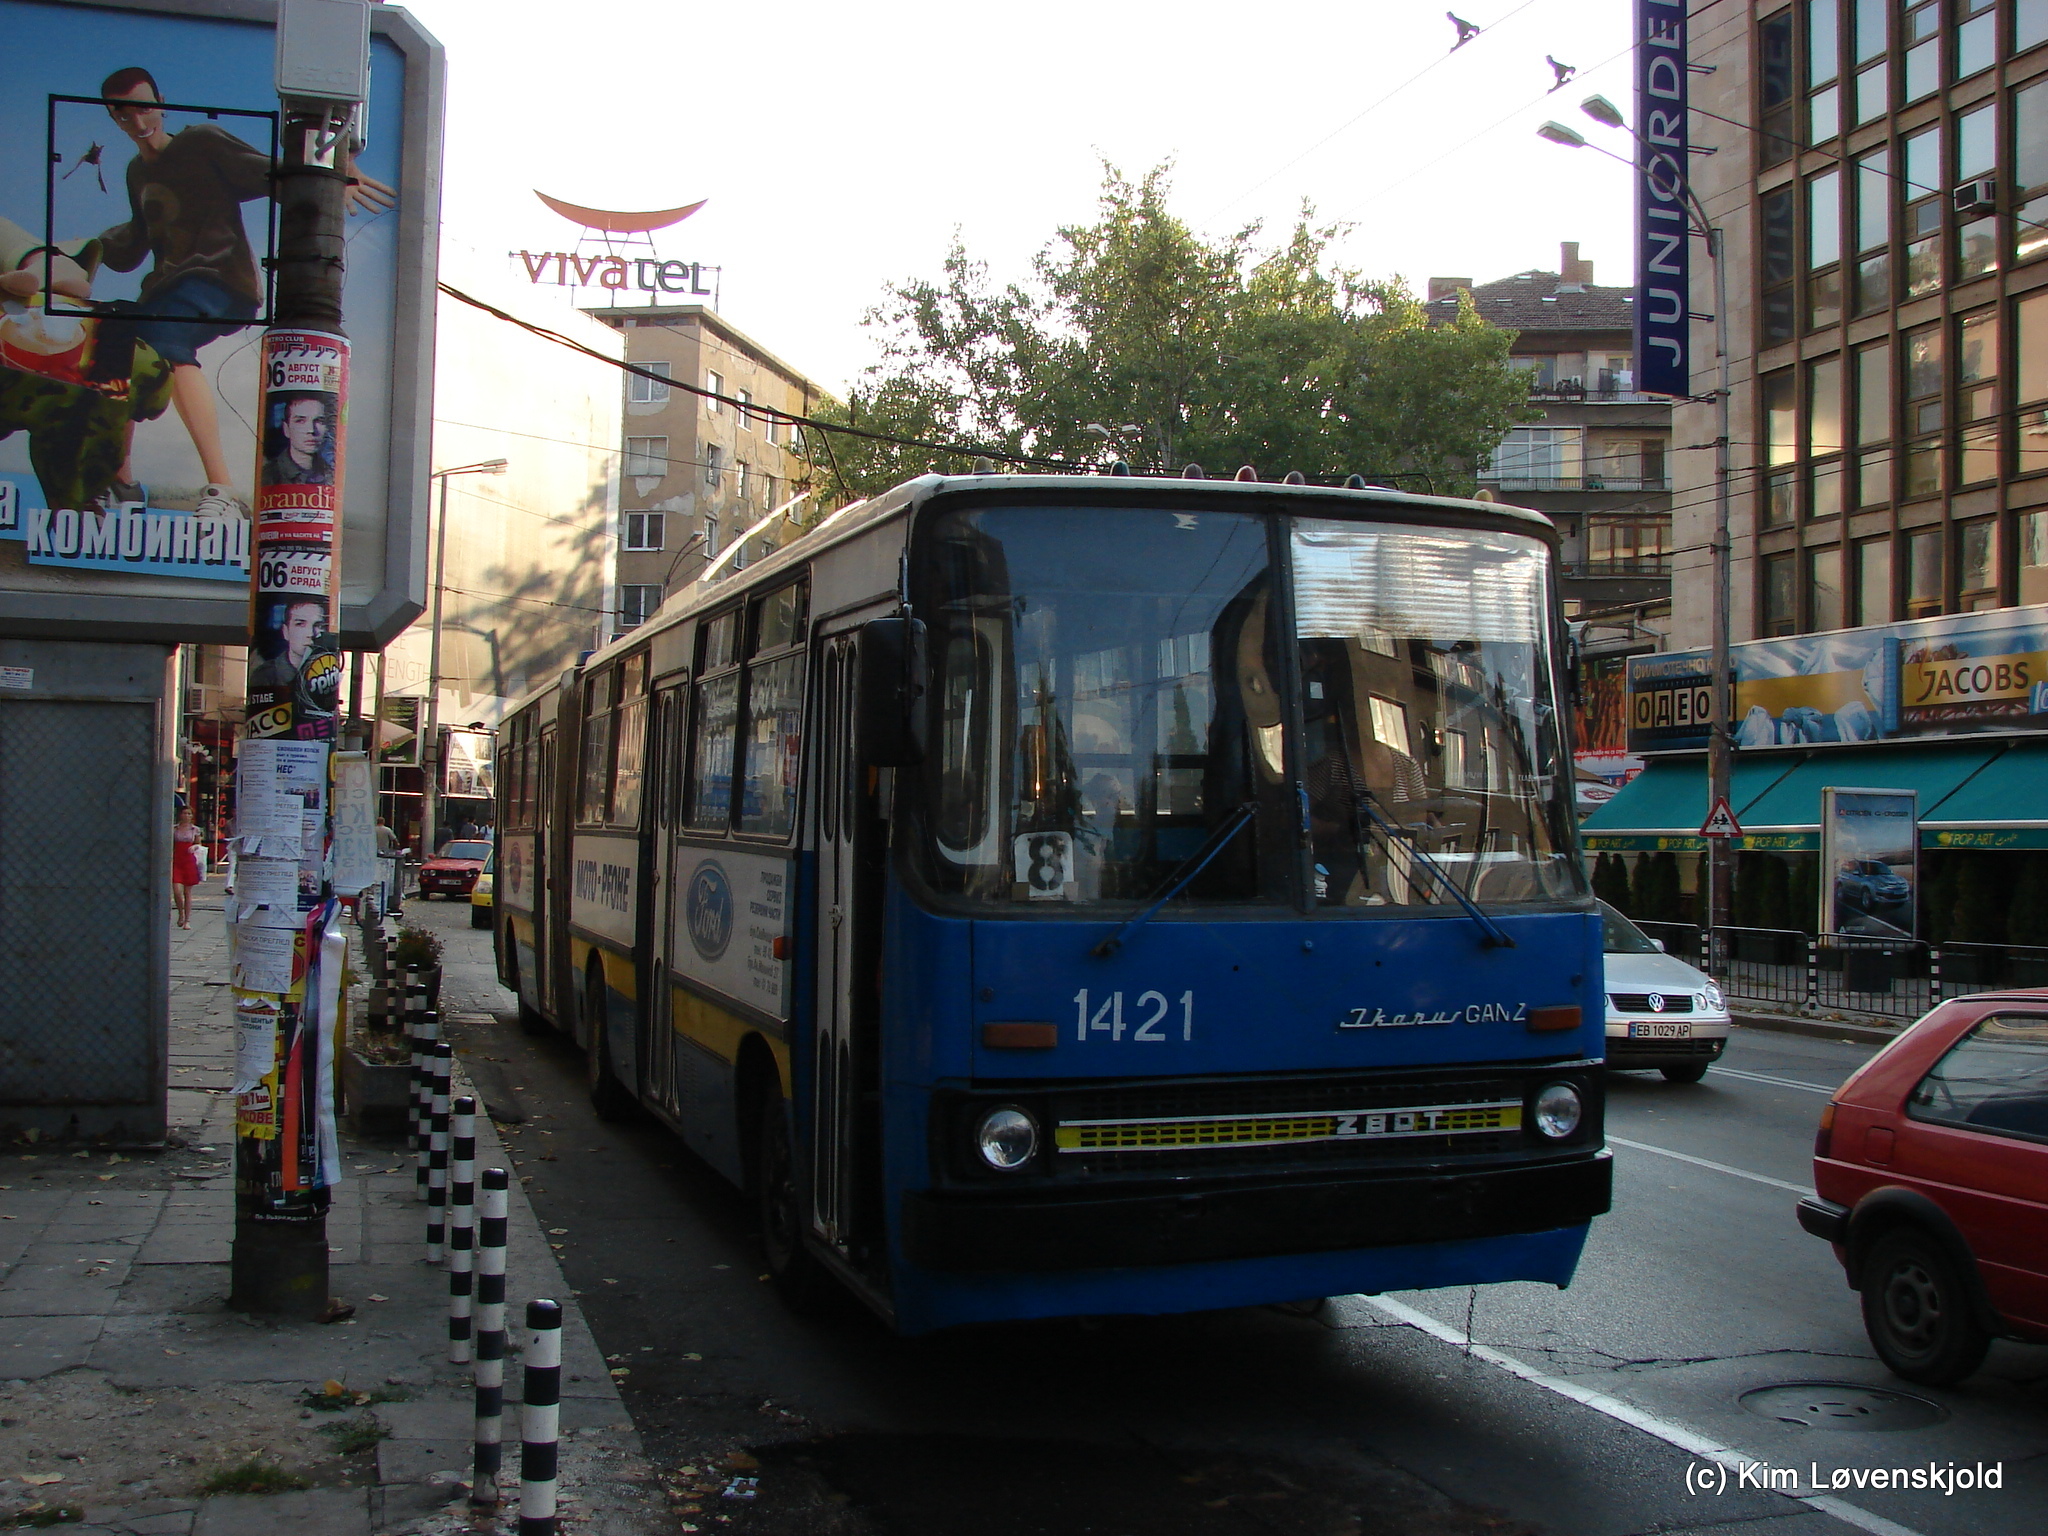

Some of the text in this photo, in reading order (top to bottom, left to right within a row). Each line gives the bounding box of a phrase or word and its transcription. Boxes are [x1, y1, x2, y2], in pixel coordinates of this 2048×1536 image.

[520, 250, 710, 295] vivatel
[288, 363, 320, 373] АВГУСТ
[287, 375, 320, 385] СРЯДА
[260, 561, 322, 588] 06 АВГУСТ
[290, 577, 321, 587] СРЯДА
[1632, 653, 1738, 680] ФИЛМОТЕЧНО КО
[1915, 661, 2029, 703] JACOBS
[251, 692, 274, 704] STAGE
[1636, 688, 1733, 727] ОДЕО
[1683, 838, 1696, 849] ART
[1755, 836, 1771, 847] POP
[1772, 836, 1787, 847] ART
[1951, 833, 1974, 845] POP
[1974, 832, 1995, 845] ART
[1027, 834, 1064, 892] 8
[698, 878, 723, 945] Ford
[1073, 987, 1193, 1042] 1421
[1339, 1007, 1462, 1029] Ikarus
[1636, 1025, 1689, 1036] EB 1029 AP
